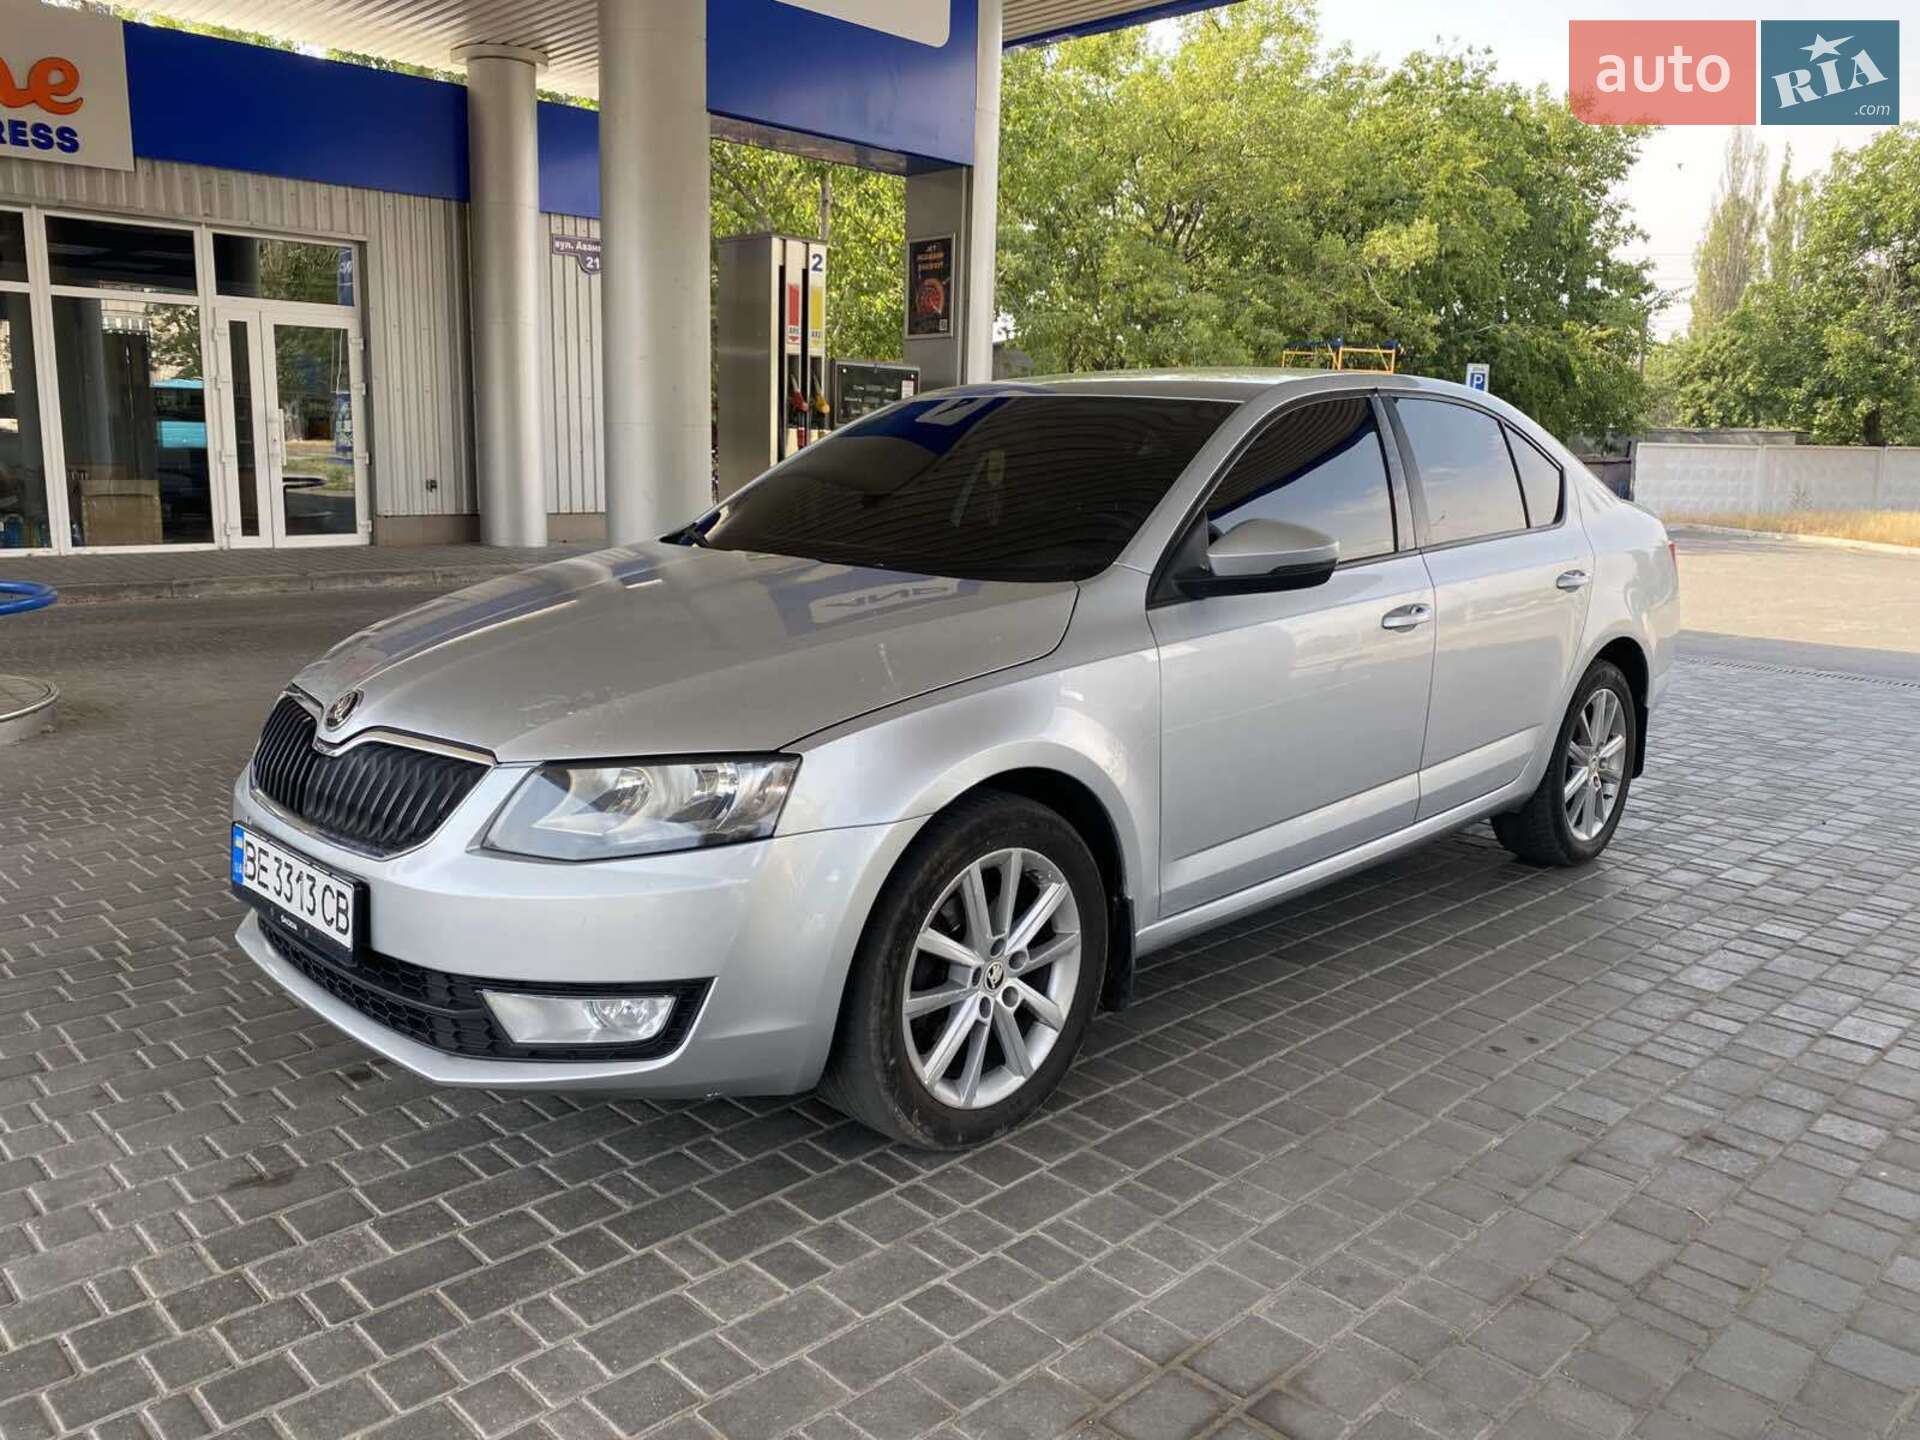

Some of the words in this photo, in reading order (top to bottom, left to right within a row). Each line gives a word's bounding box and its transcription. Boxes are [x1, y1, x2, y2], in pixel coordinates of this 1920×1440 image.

[586, 256, 600, 270] 21
[811, 253, 824, 272] 2
[1472, 374, 1484, 390] P
